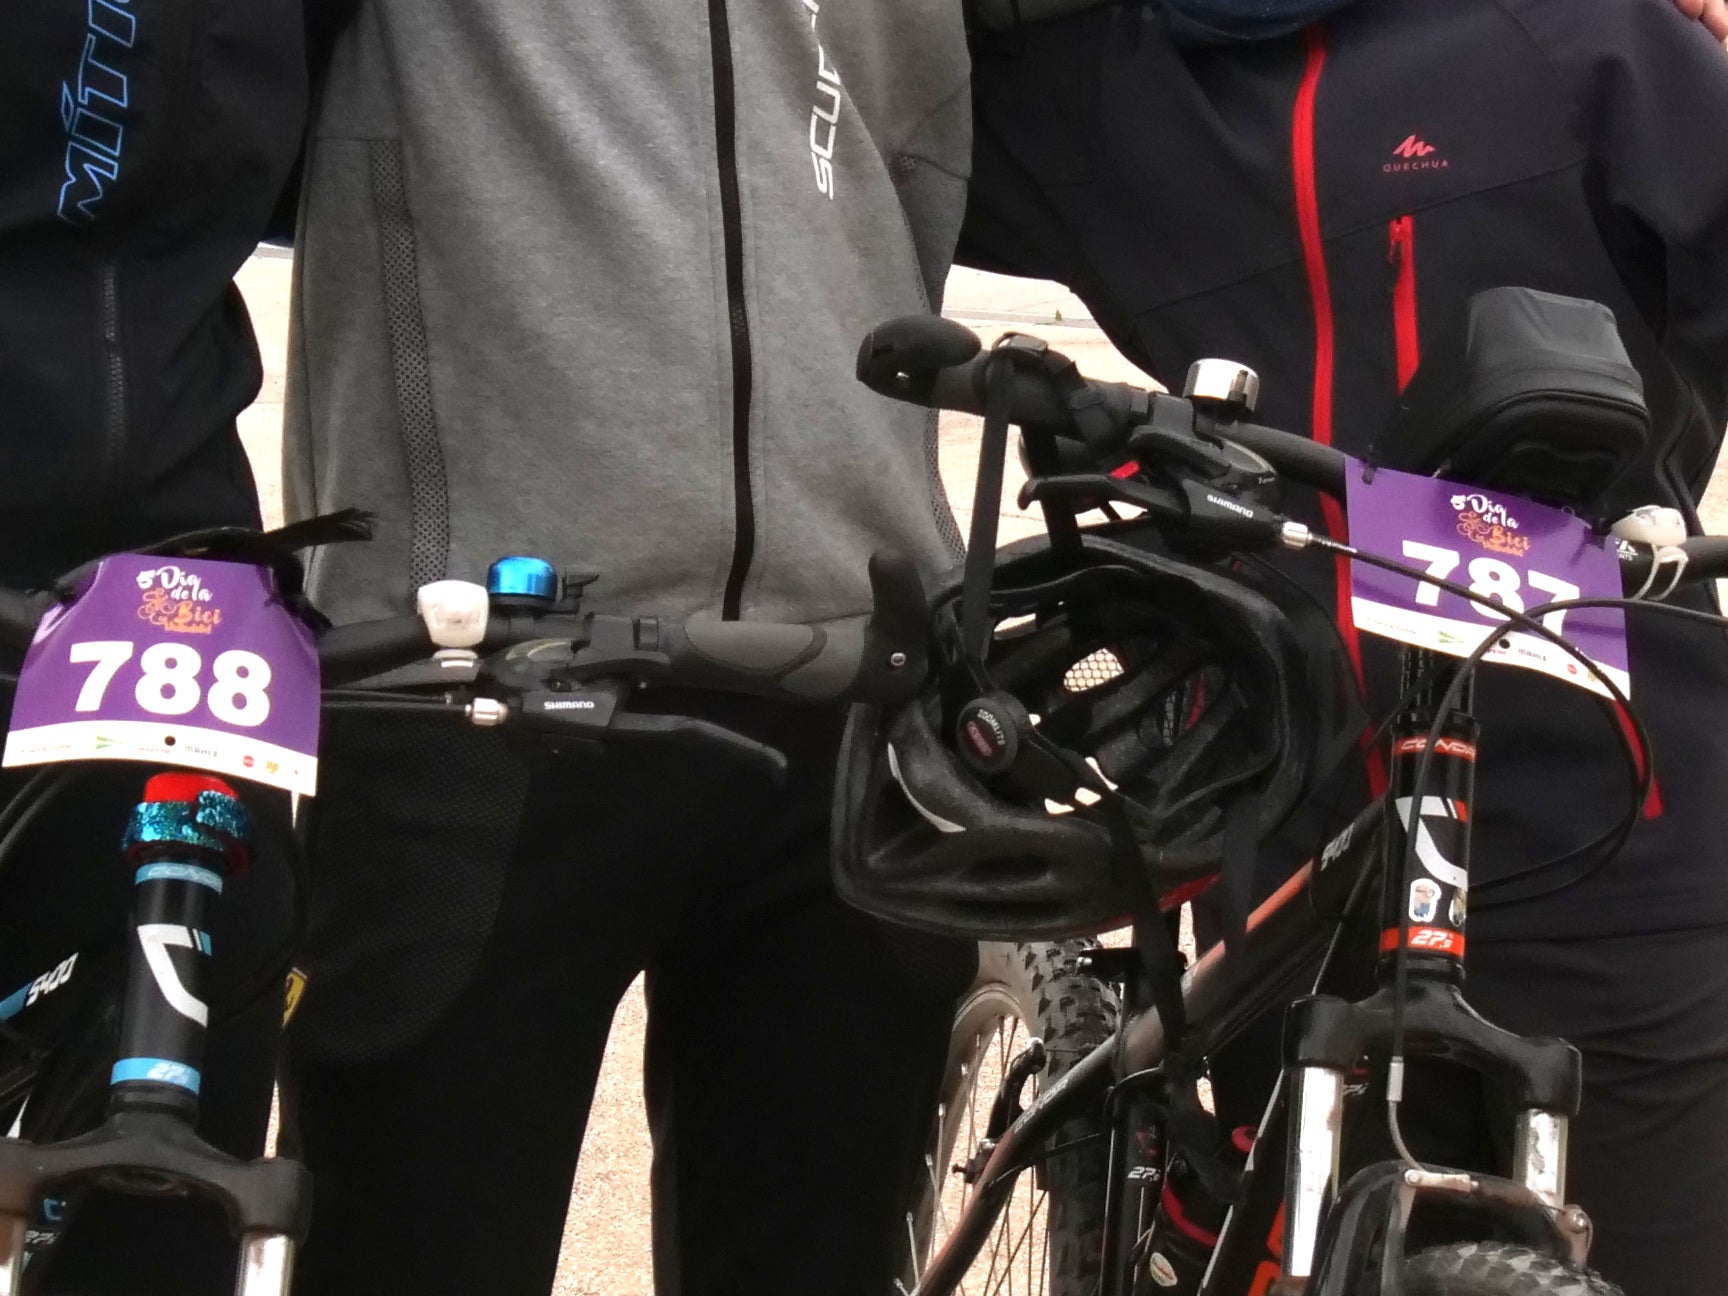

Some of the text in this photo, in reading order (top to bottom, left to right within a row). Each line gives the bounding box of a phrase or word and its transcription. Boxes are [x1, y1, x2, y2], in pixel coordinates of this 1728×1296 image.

[1383, 159, 1449, 173] QUECHUA
[1205, 493, 1255, 519] SHIMANO
[1402, 540, 1580, 639] 787
[174, 600, 222, 625] Bici
[69, 640, 272, 728] 788
[543, 699, 595, 711] SHIMANO
